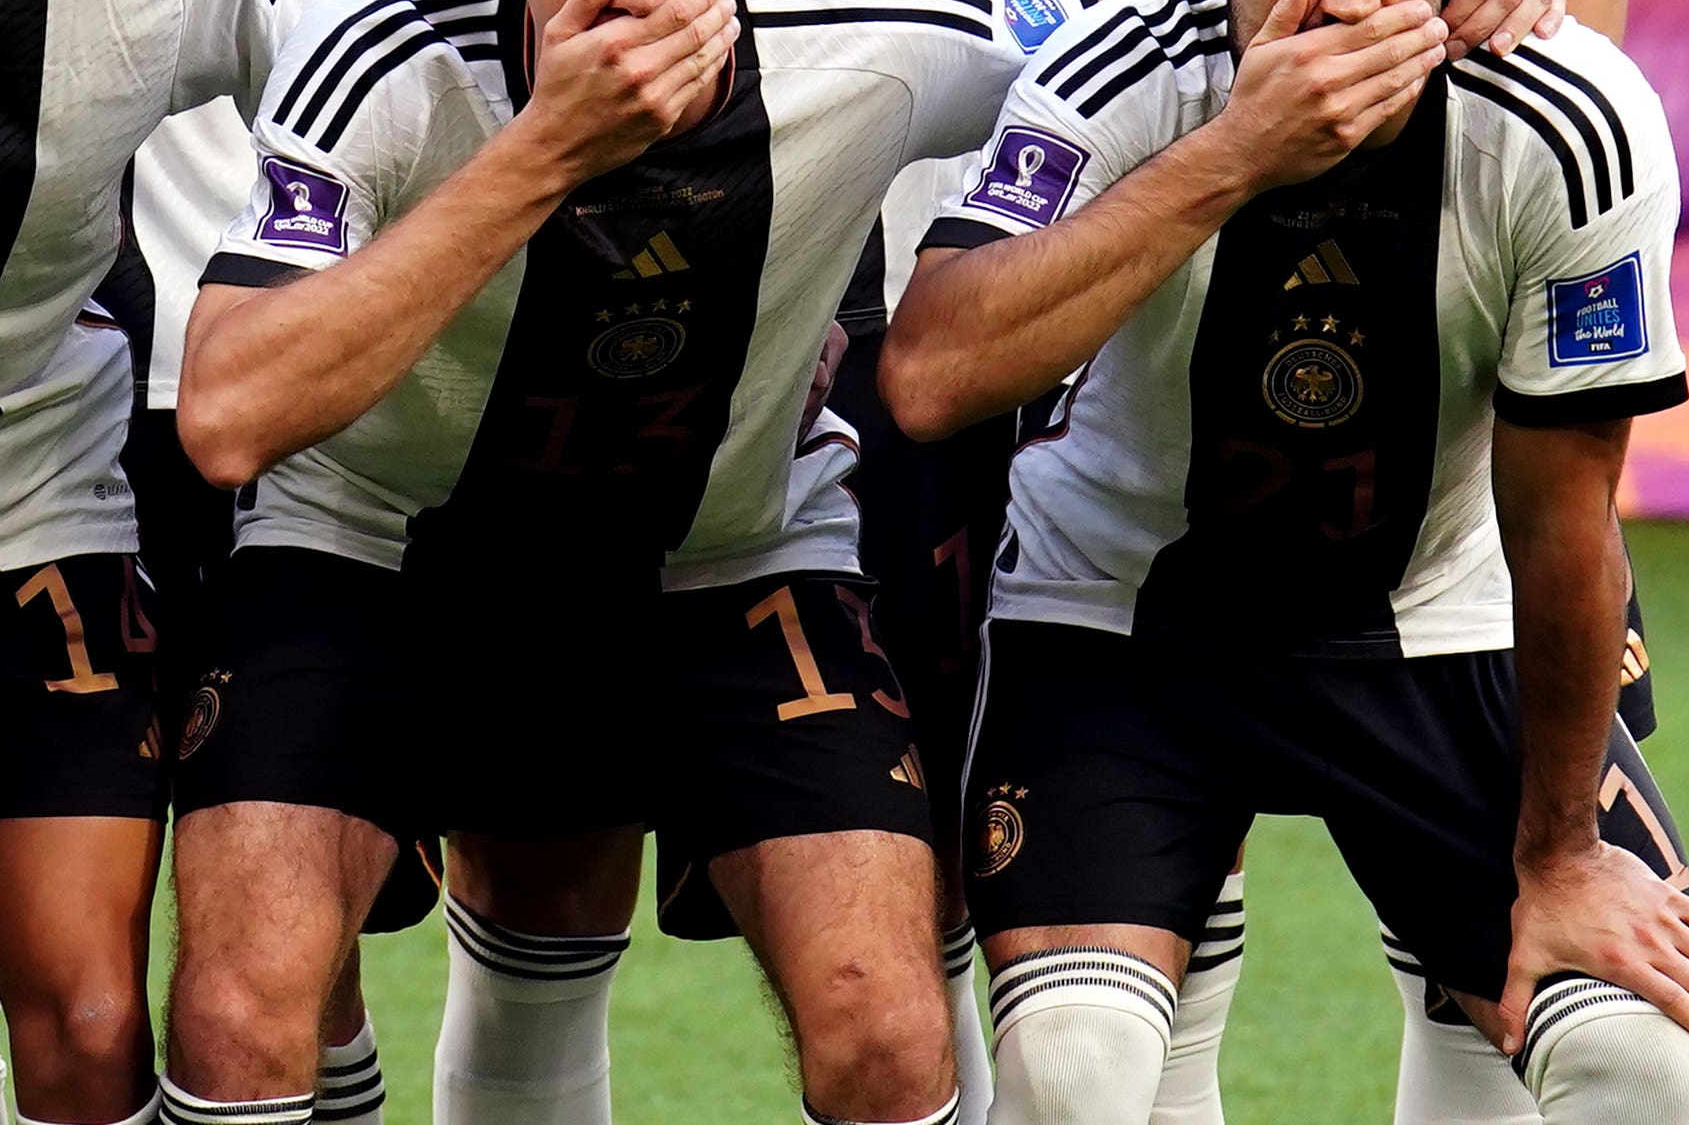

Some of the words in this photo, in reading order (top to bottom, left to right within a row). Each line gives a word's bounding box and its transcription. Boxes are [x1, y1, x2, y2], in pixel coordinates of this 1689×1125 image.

[670, 186, 693, 199] 2022
[688, 188, 725, 205] STADIUM
[1002, 183, 1032, 200] WORLD
[1031, 192, 1049, 206] CUP
[317, 218, 335, 229] CUP
[1576, 297, 1620, 319] FOOTBALL
[1575, 308, 1621, 329] UNITES
[1574, 327, 1592, 342] the
[1592, 323, 1625, 339] World
[1590, 342, 1612, 352] FIFA
